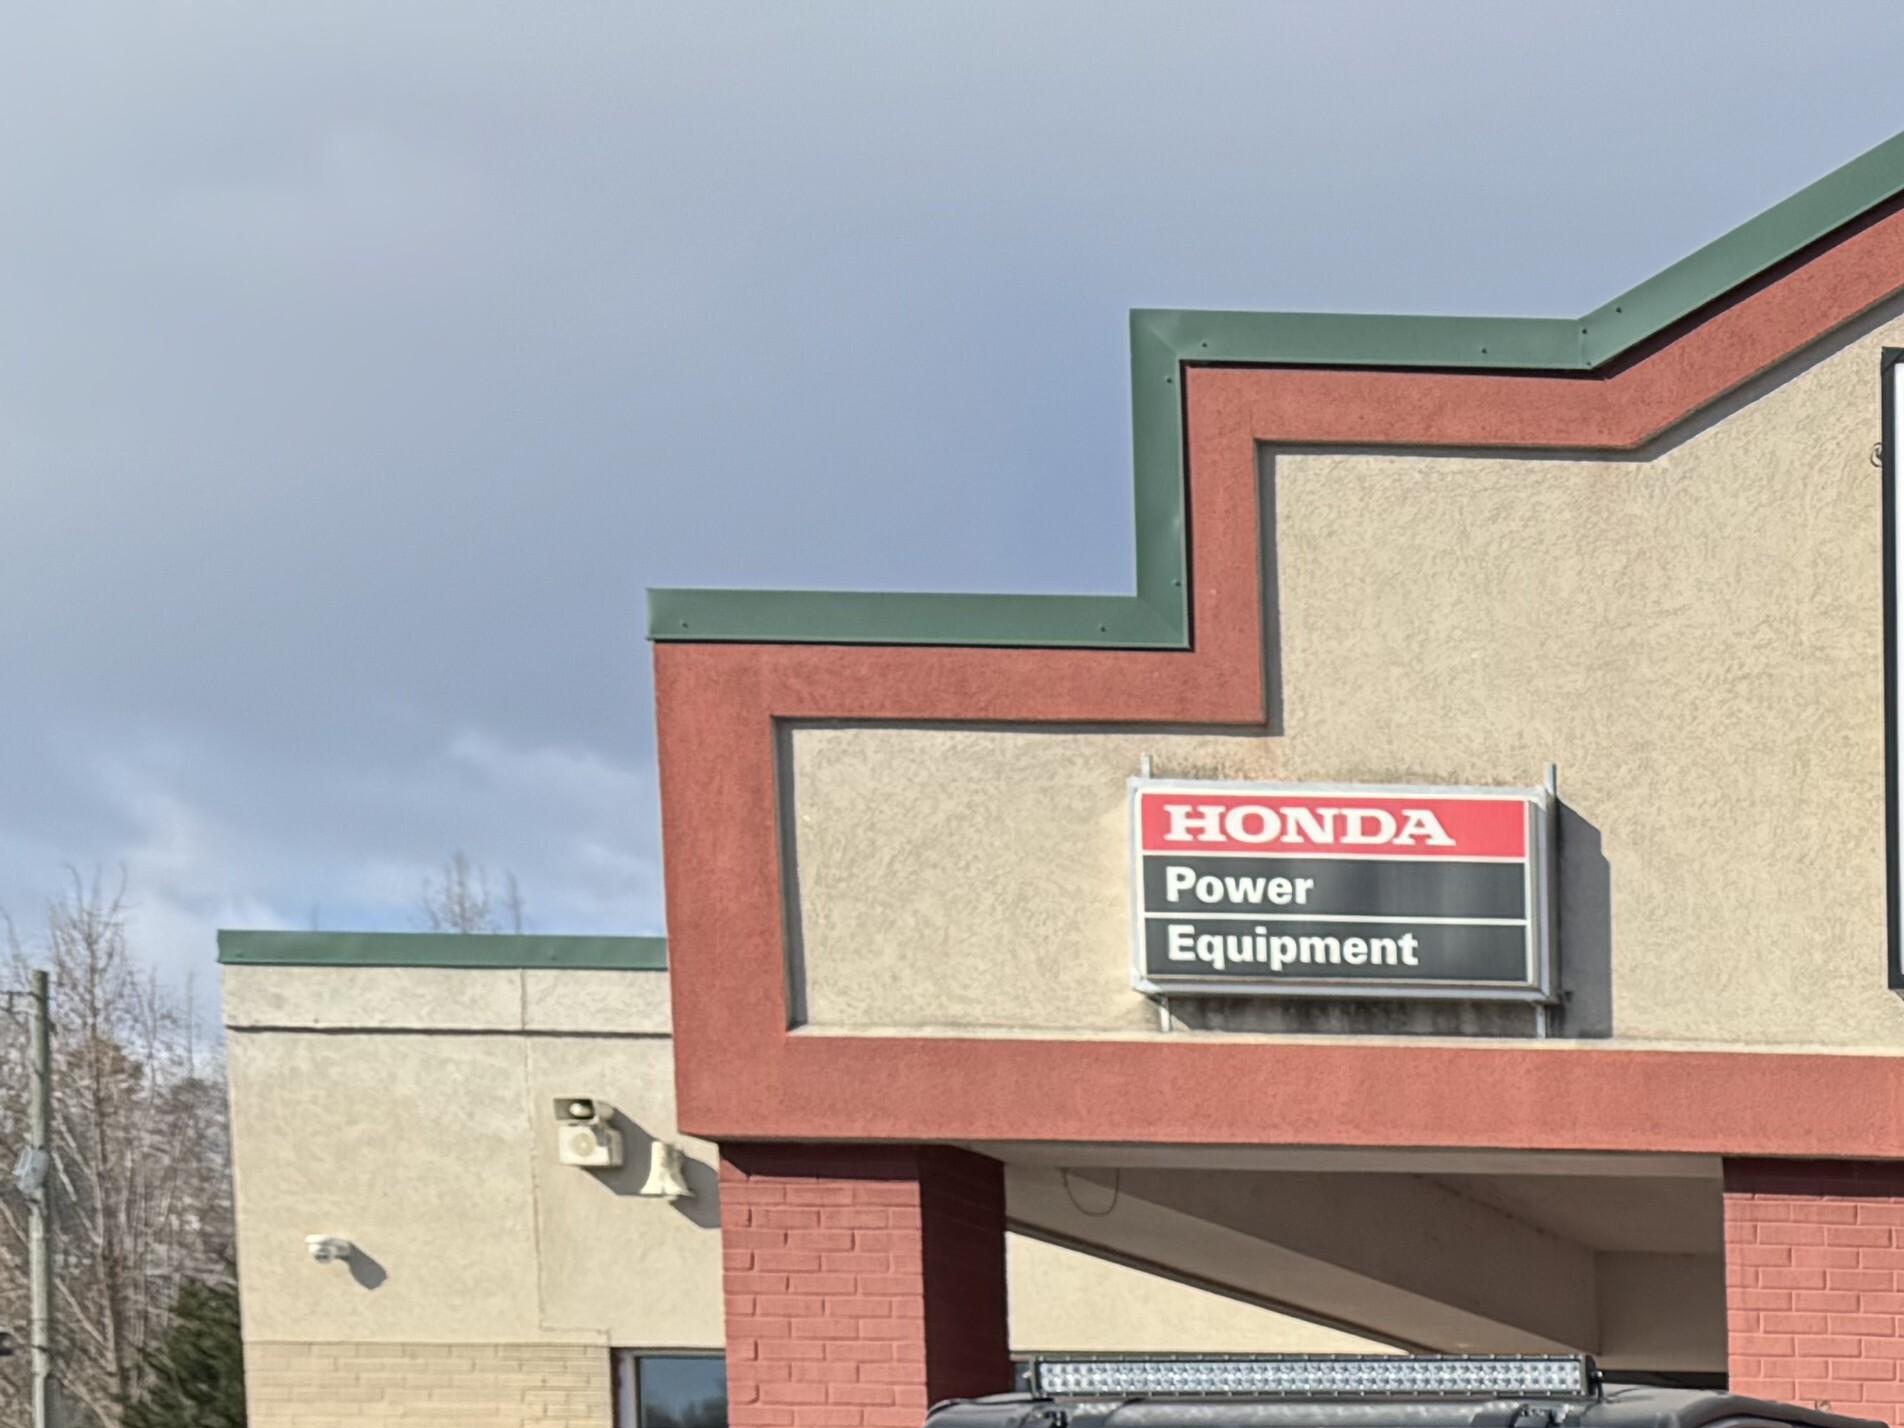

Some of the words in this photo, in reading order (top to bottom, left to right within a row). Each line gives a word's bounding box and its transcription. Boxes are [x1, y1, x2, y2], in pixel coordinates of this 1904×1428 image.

[1163, 804, 1456, 847] HONDA
[1165, 865, 1315, 905] Power
[1167, 924, 1420, 971] Equipment
